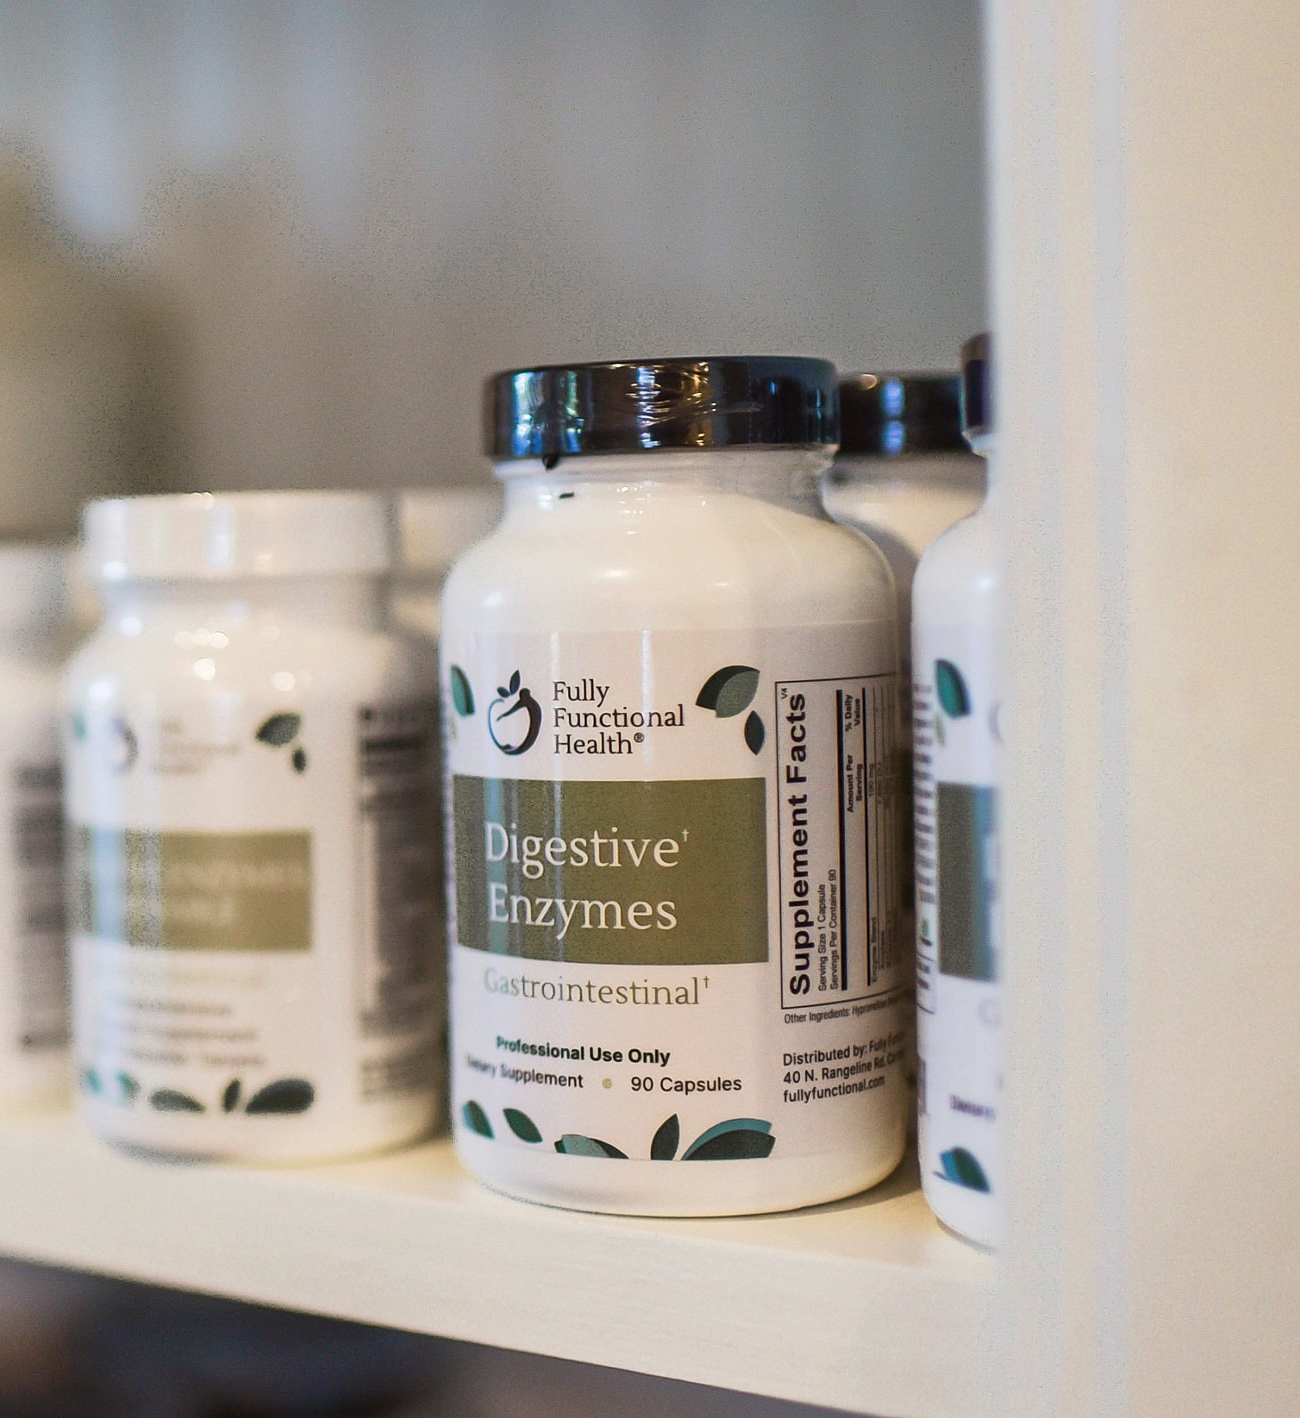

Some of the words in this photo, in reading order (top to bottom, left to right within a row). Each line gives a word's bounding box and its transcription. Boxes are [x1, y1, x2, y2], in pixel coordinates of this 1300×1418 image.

[553, 679, 610, 707] Fully
[554, 704, 685, 728] Functional
[845, 695, 853, 720] Daily
[786, 693, 807, 783] Facts
[846, 775, 854, 813] Amount
[828, 869, 837, 881] 90
[788, 794, 815, 995] Supplement
[817, 884, 828, 923] Capsule
[829, 884, 837, 929] Container
[489, 881, 677, 940] Enzymes
[818, 933, 826, 954] Size
[829, 931, 837, 948] Per
[818, 956, 828, 991] Serving
[830, 950, 840, 990] Servings
[784, 1013, 806, 1024] Other
[496, 1035, 585, 1061] Professional
[590, 1047, 623, 1063] Use
[628, 1048, 670, 1067] Only
[783, 1045, 851, 1066] Distributed
[853, 1044, 868, 1059] by:
[500, 1063, 584, 1088] Supplement
[783, 1070, 801, 1084] 40
[804, 1069, 818, 1082] N.
[822, 1060, 872, 1080] Rangeline
[631, 1077, 654, 1092] 90
[660, 1077, 742, 1095] Capsules
[783, 1076, 886, 1103] fullyfunctional.com
